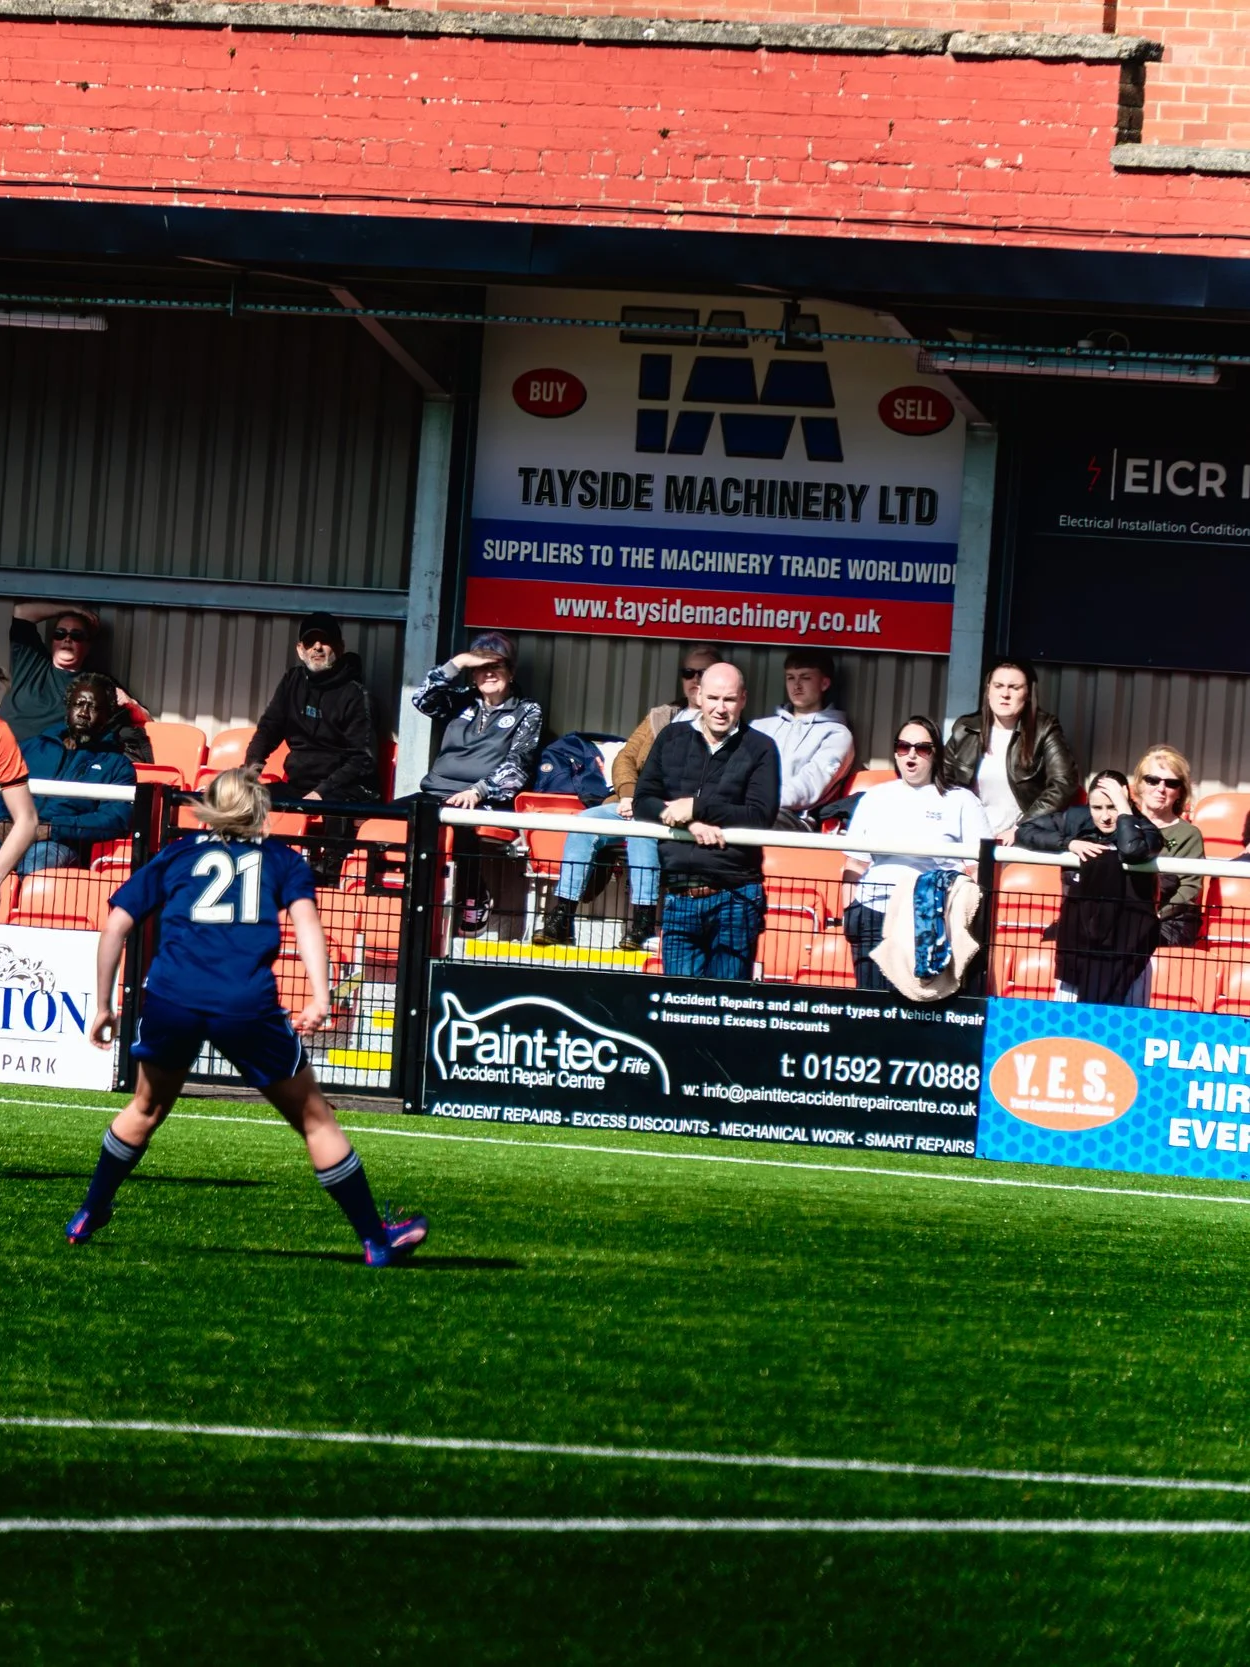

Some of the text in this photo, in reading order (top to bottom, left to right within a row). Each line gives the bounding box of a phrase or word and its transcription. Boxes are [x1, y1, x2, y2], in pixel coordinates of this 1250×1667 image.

[529, 381, 567, 402] BUY
[893, 399, 937, 421] SELL
[1124, 457, 1227, 498] EICR
[518, 467, 937, 526] TAYSIDE MACHINERY LTD
[1059, 514, 1114, 530] Electrical
[1117, 518, 1187, 534] Installation
[483, 538, 584, 566] SUPPLIERS
[590, 545, 613, 567] TO
[620, 547, 655, 570] THE
[661, 548, 773, 576] MACHINERY
[780, 554, 841, 580] TRADE
[554, 596, 882, 635] www.taysidemachinery.co.uk
[190, 850, 263, 924] 21
[661, 1010, 830, 1033] Insurance Excess Discounts
[664, 993, 985, 1027] Accident Repairs and all other types of Vehicle Repair
[450, 1020, 618, 1073] Paint-tec
[2, 1056, 57, 1075] PARK
[450, 1064, 605, 1090] Accident Repair Centre
[620, 1058, 650, 1075] Fife
[781, 1053, 980, 1091] t: 01592 770888
[682, 1082, 977, 1117] w: info@painttecaccidentrepaircentre.co.uk
[432, 1102, 501, 1120] ACCIDENT
[503, 1109, 561, 1124] REPAIRS
[571, 1112, 627, 1129] EXCESS
[628, 1116, 709, 1135] DISCOUNTS
[721, 1122, 808, 1142] MECHANICAL
[811, 1129, 854, 1146] WORK
[865, 1133, 913, 1150] SMART
[915, 1137, 975, 1155] REPAIRS
